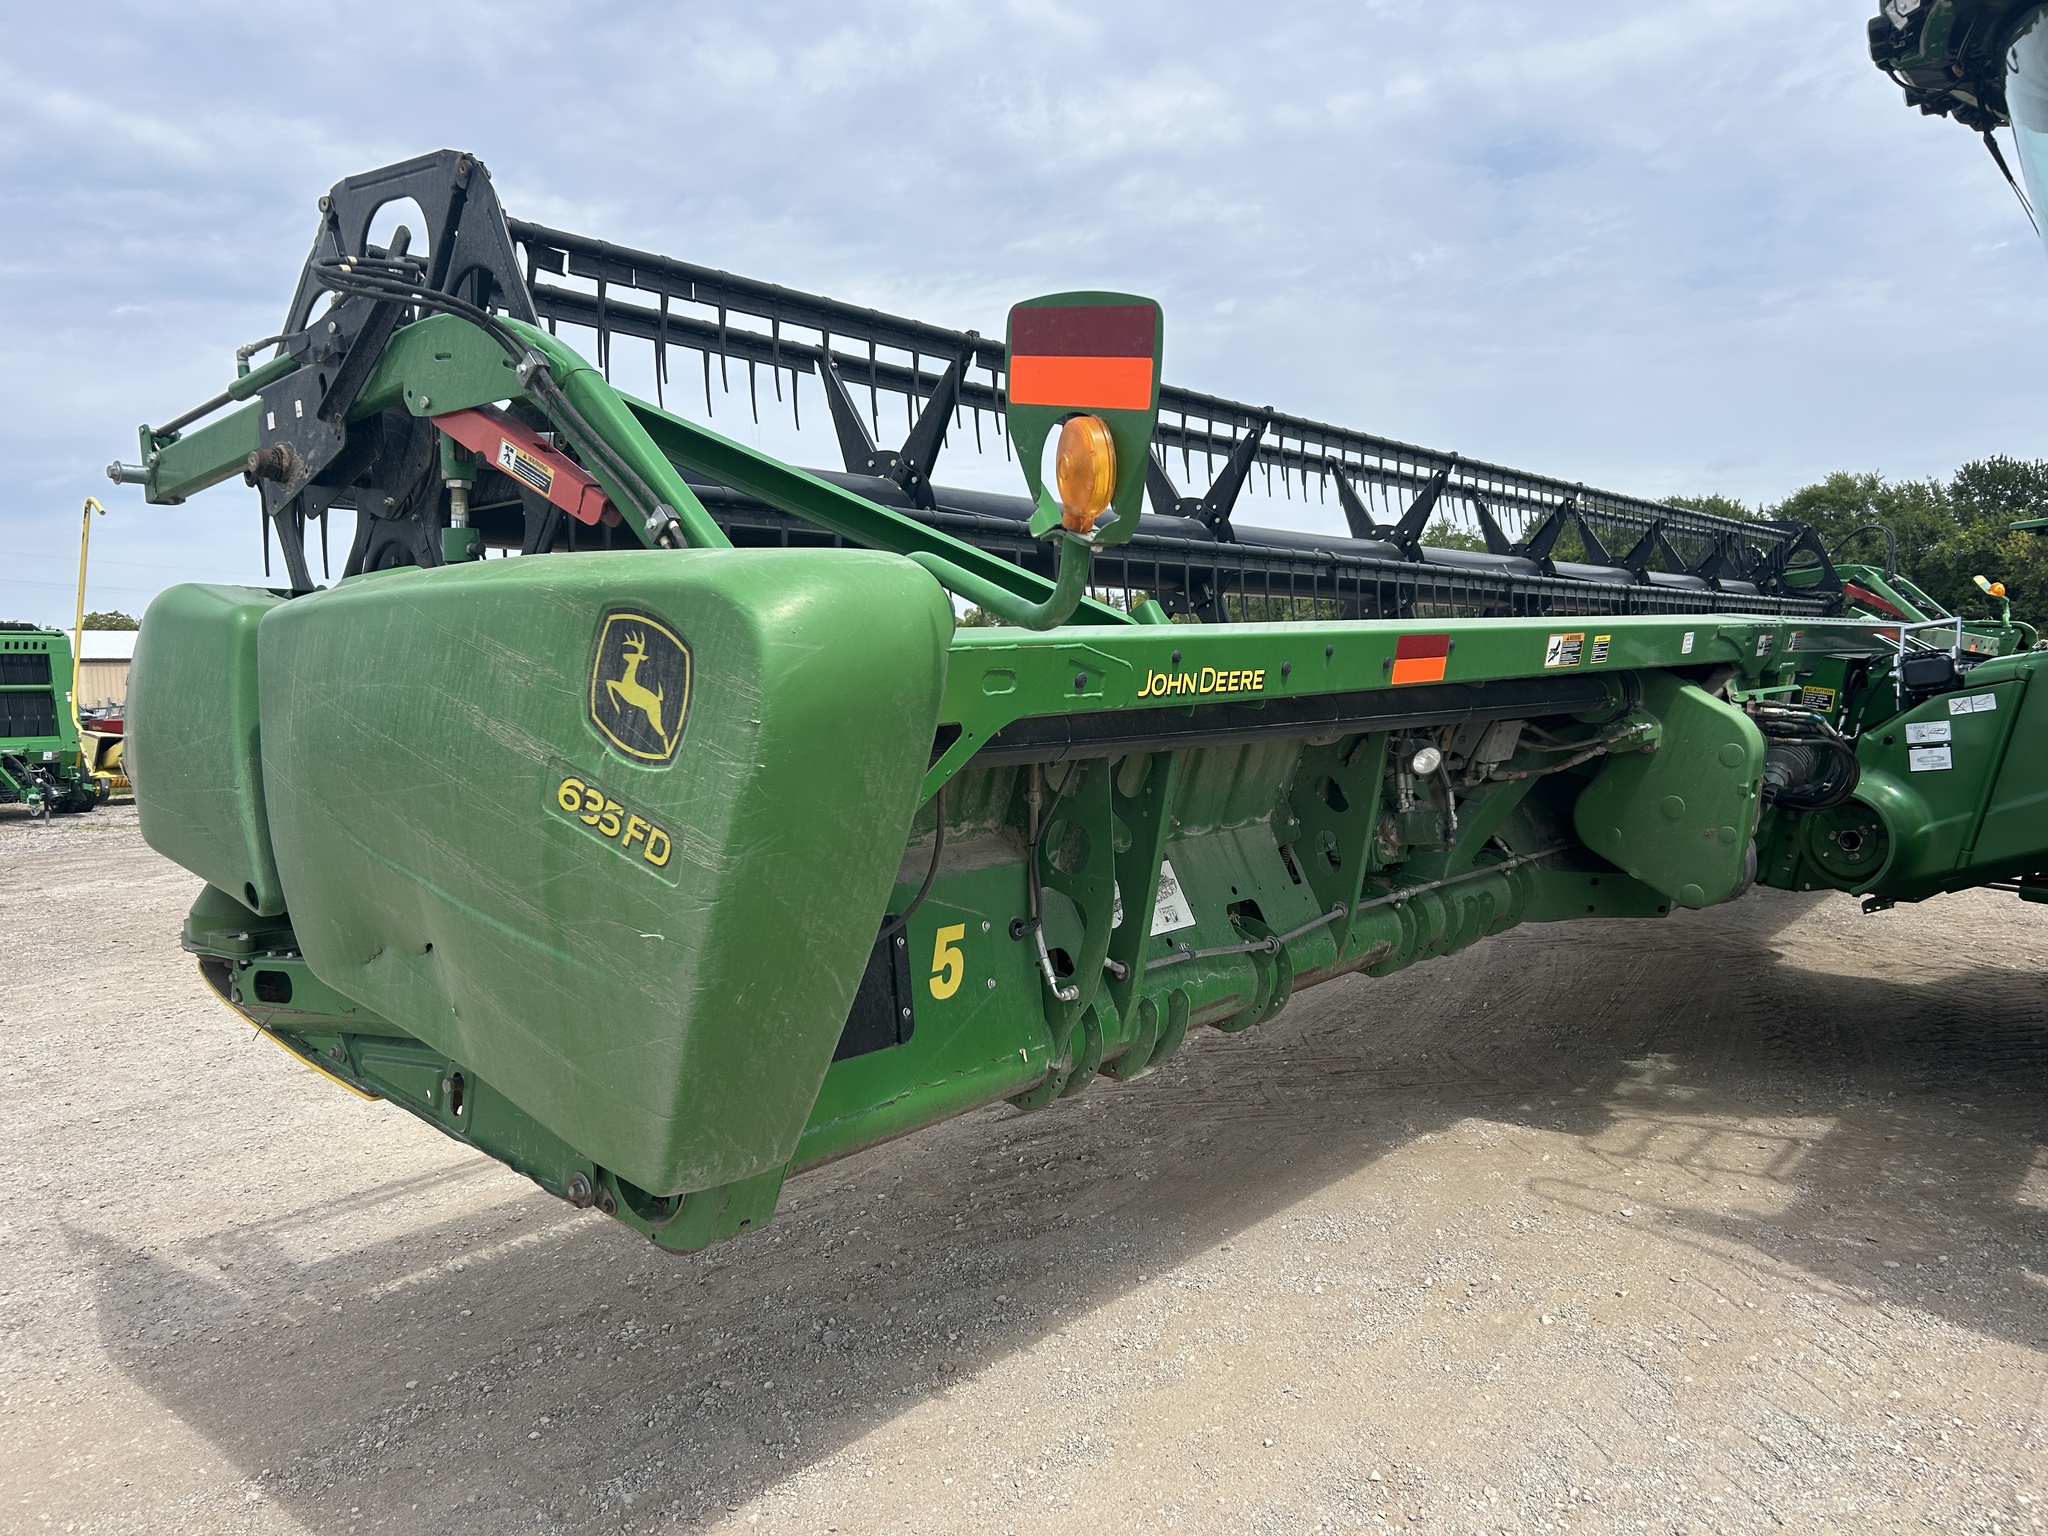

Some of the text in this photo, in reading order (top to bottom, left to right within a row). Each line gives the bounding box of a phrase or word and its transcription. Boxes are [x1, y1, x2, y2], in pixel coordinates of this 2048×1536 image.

[527, 455, 549, 472] WARNING
[1137, 667, 1266, 698] JOHN DEERE
[1809, 687, 1835, 695] CAUTION
[929, 923, 966, 1001] 5
